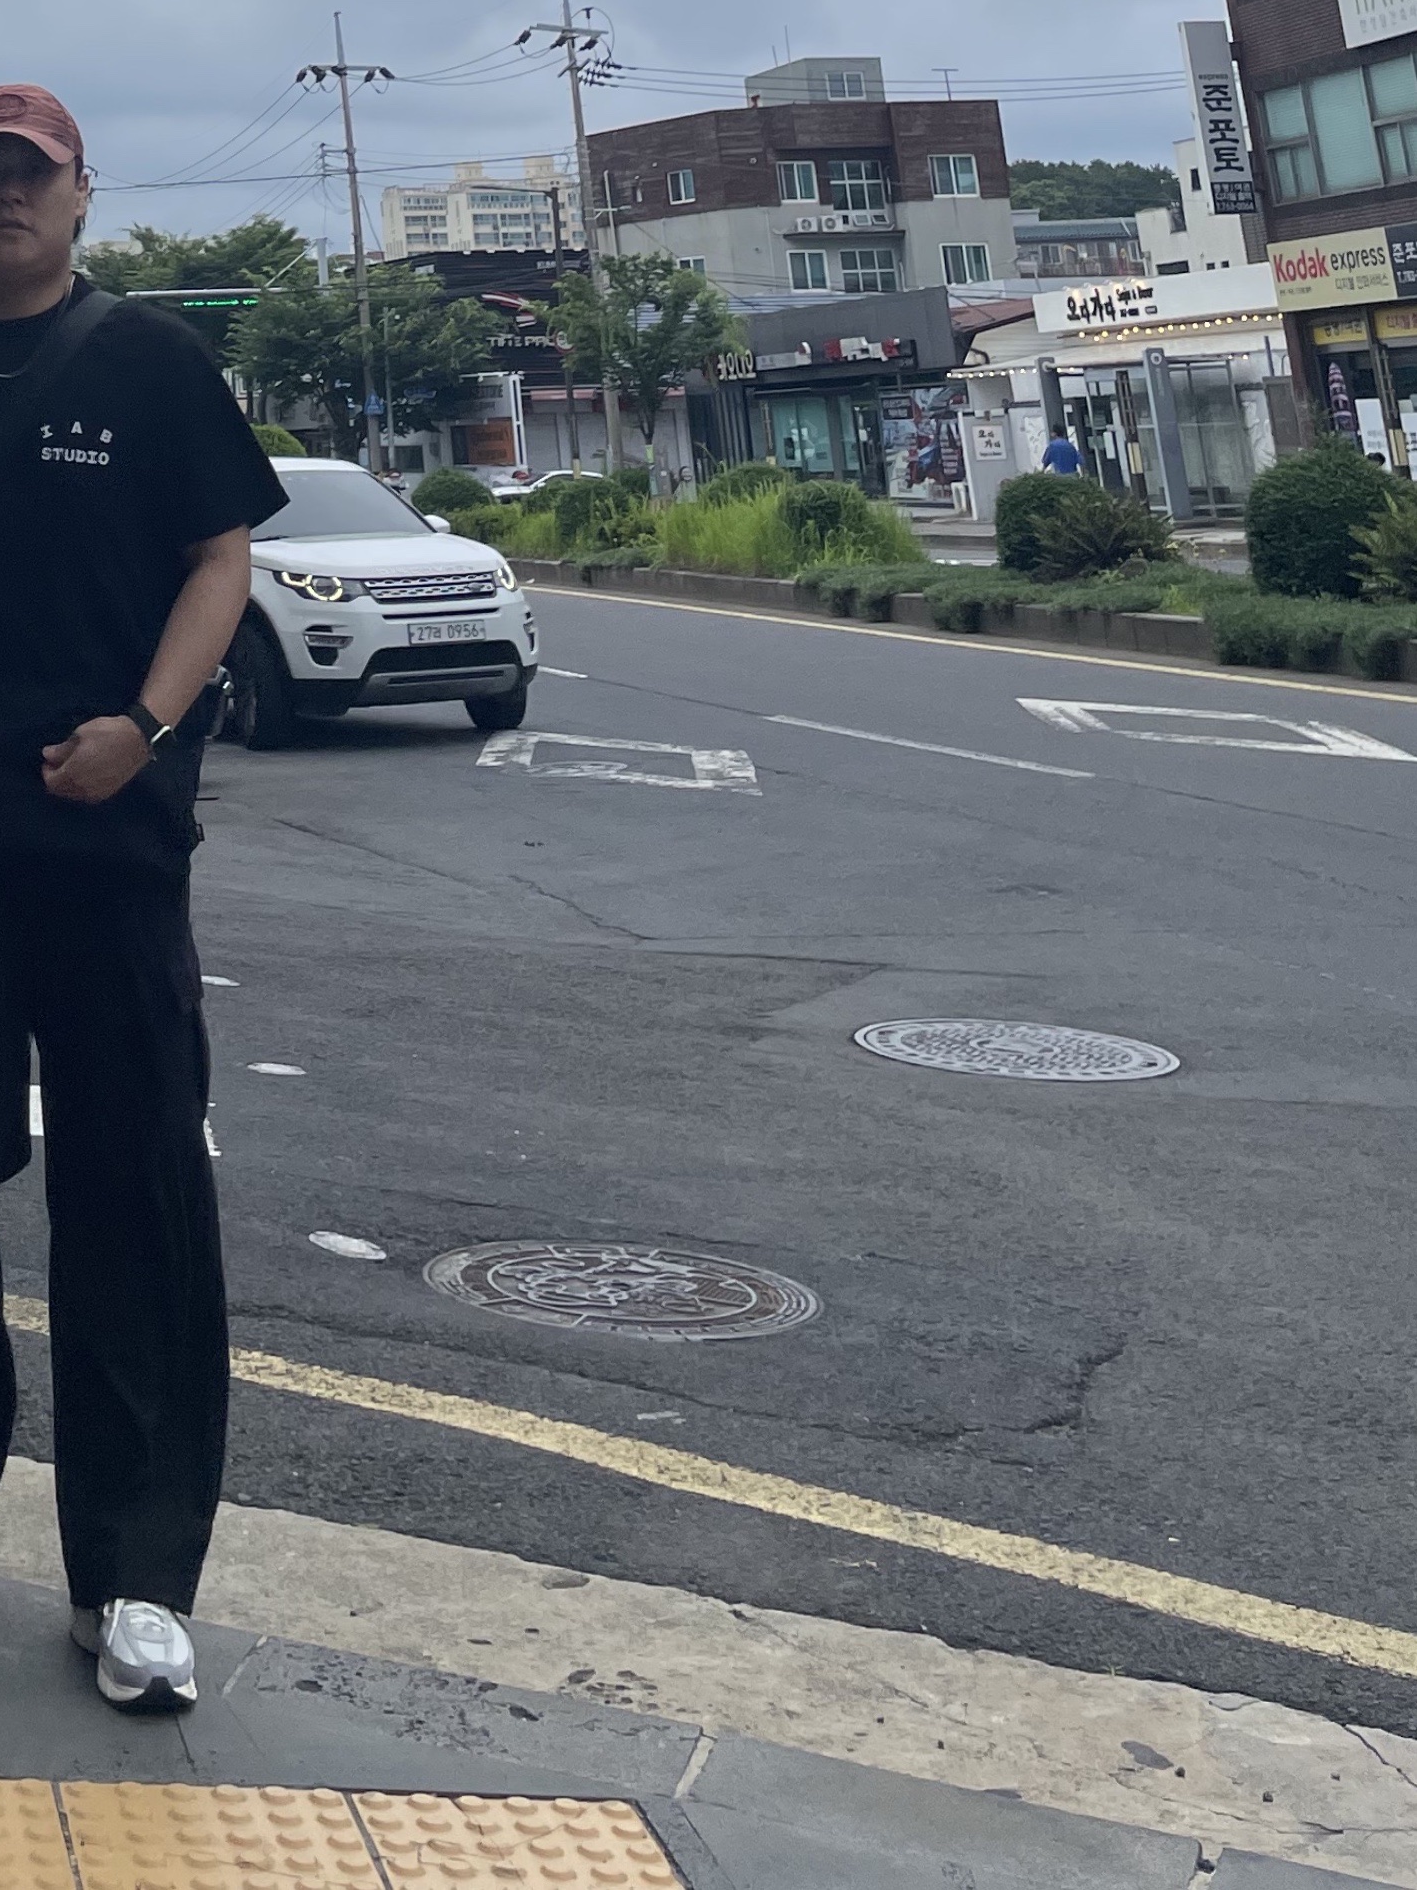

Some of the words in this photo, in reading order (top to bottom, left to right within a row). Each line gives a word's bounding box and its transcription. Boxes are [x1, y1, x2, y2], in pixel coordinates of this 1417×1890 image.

[1273, 247, 1330, 284] Kodak
[1330, 246, 1386, 273] express
[41, 447, 110, 466] STUDIO
